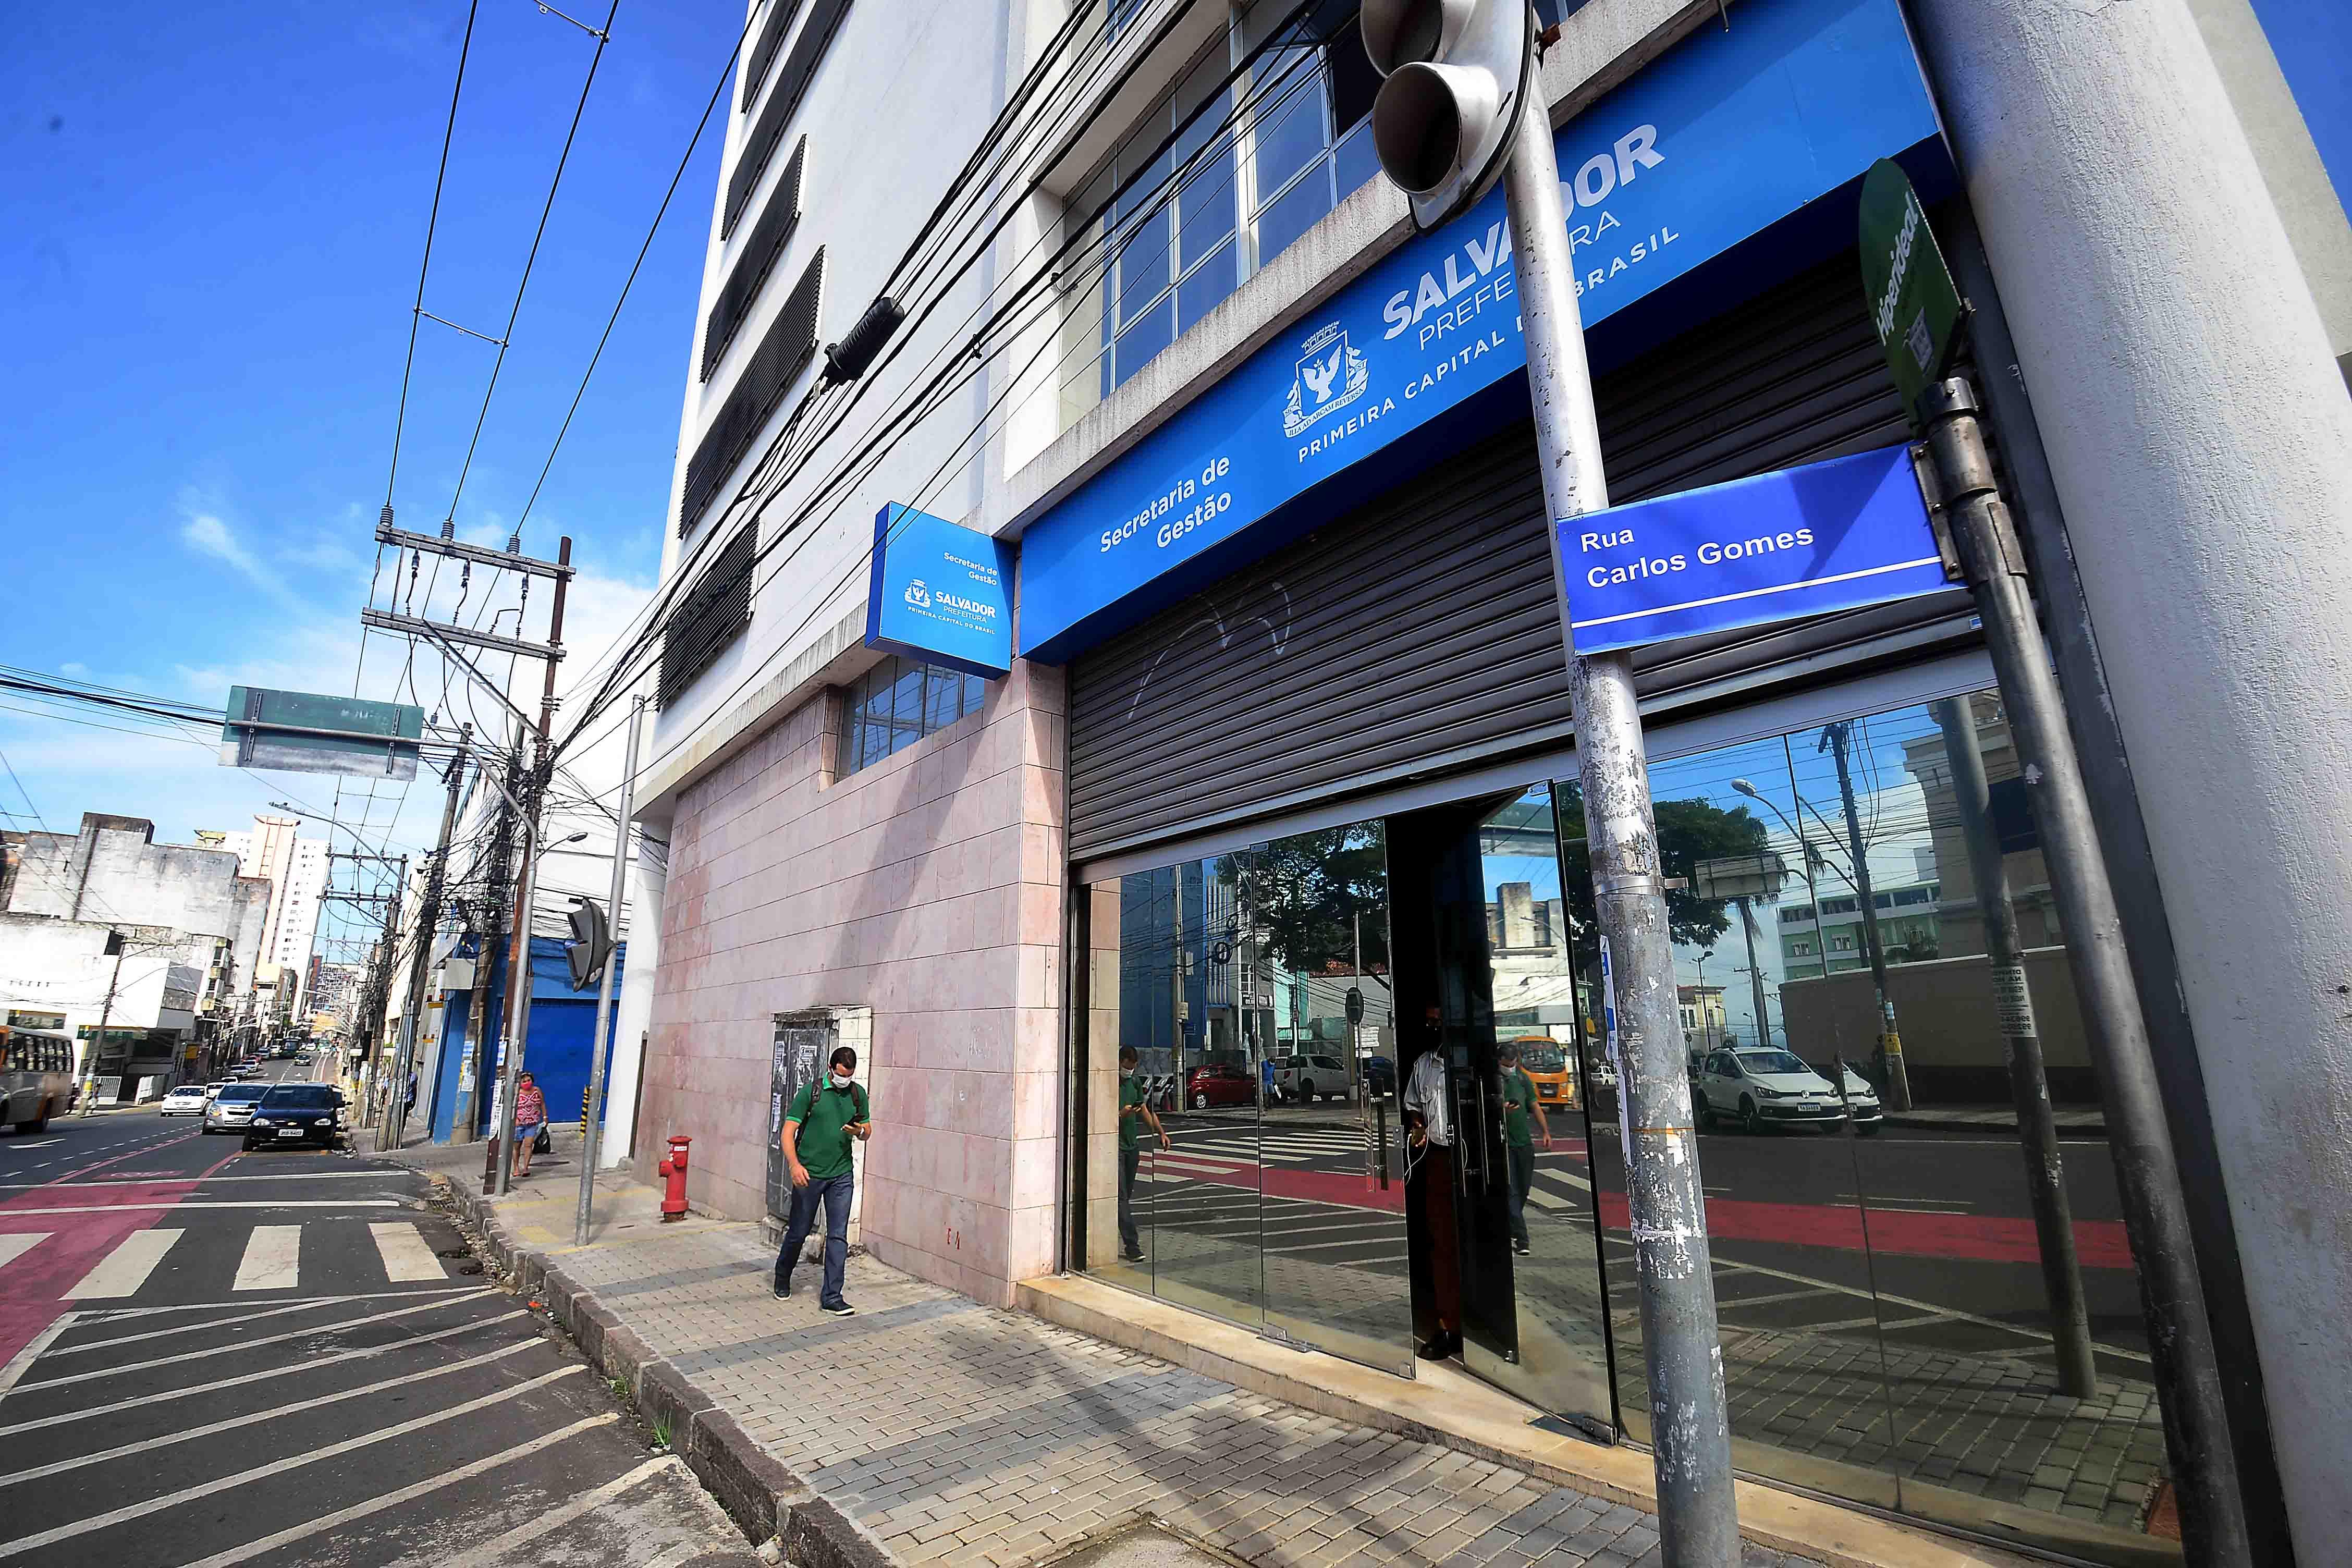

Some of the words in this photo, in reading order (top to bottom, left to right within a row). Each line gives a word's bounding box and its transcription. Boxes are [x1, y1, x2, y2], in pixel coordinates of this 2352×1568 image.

[1419, 210, 1621, 351] PREFERA
[1298, 397, 1396, 463] PRIMEIRA
[1404, 330, 1505, 400] CAPITAL
[1100, 479, 1195, 553] Secretaria
[1201, 456, 1230, 486] de
[1156, 492, 1232, 548] Gestão
[1580, 527, 1635, 553] Rua
[944, 552, 985, 572] Secretaria
[986, 567, 997, 576] de
[1587, 553, 1687, 589] Carlos
[1696, 526, 1815, 566] Gomes
[968, 571, 997, 586] Gestão
[935, 591, 997, 618] SALVADOR
[944, 605, 987, 623] PREFEITURA
[908, 606, 937, 619] PRIMEIRA
[938, 615, 963, 626] CAPITAL
[975, 624, 995, 634] BRASIL
